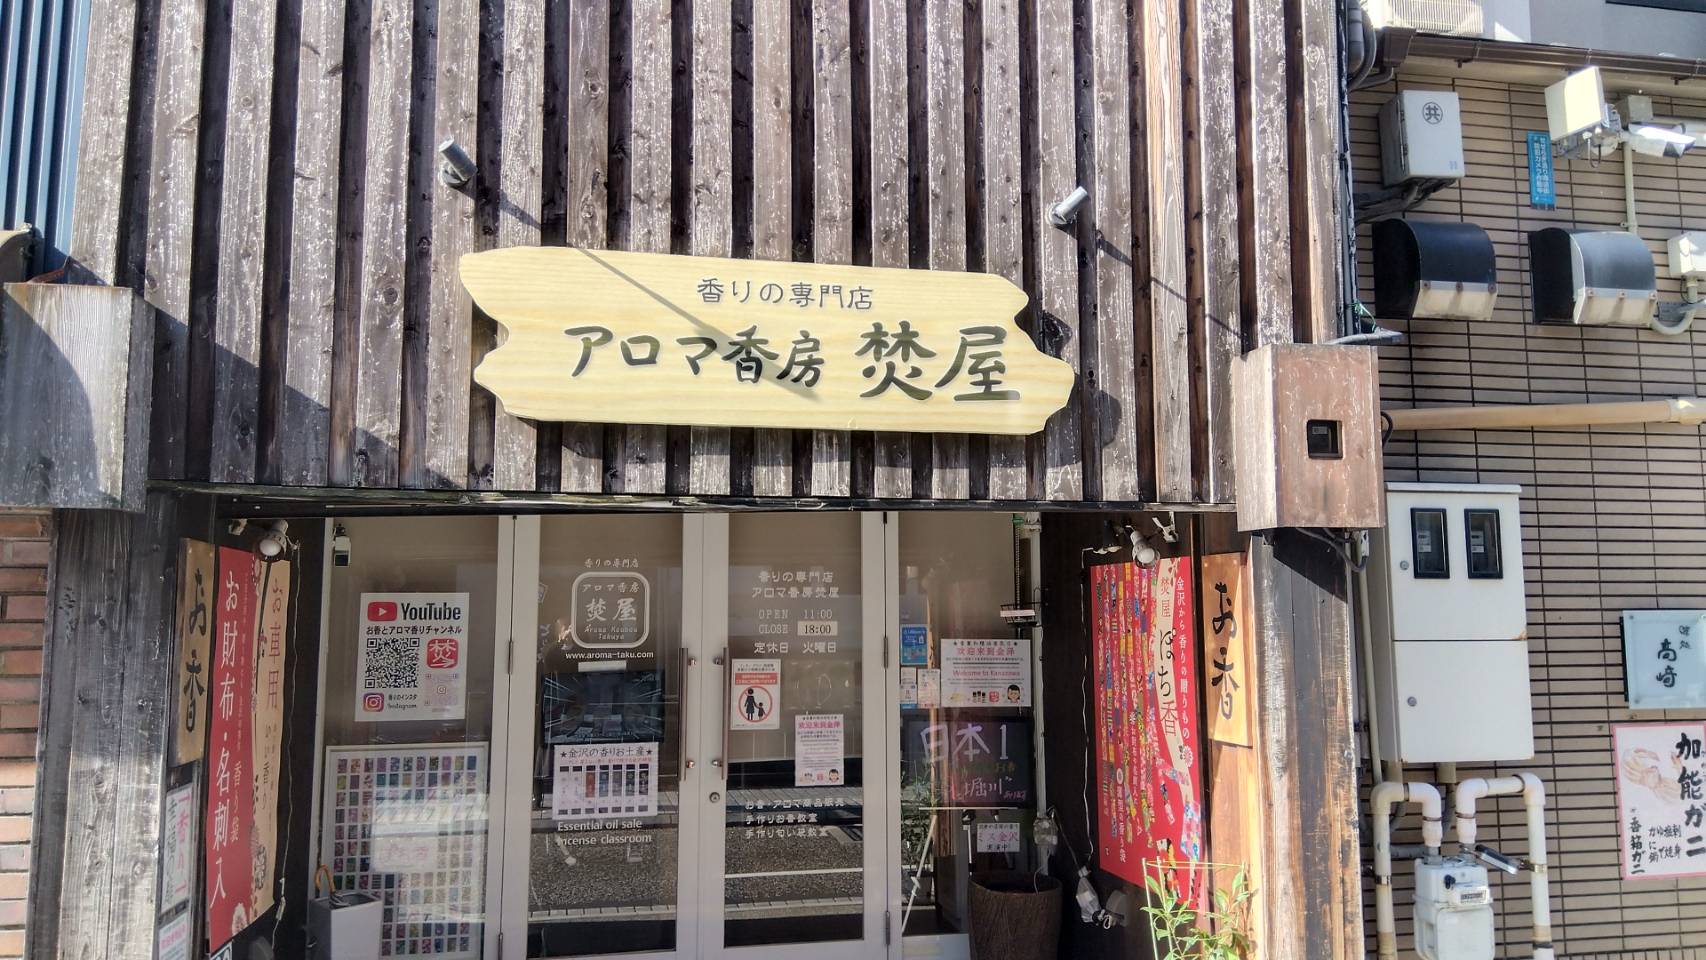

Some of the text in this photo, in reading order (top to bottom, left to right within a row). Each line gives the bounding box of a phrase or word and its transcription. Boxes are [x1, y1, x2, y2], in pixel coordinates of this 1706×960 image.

[697, 277, 874, 311] 香りの専門店
[564, 320, 1021, 402] アロマ香房 焚屋
[584, 558, 639, 568] 香りの専門店
[758, 570, 833, 582] 香りの専門店
[582, 581, 640, 593] アロマ香房
[752, 586, 839, 598] アロマ香房焚屋
[1160, 578, 1171, 618] 焚屋
[401, 602, 461, 620] YouTube
[585, 597, 637, 621] 焚屋
[759, 609, 833, 619] OPEN 11:00
[759, 624, 831, 634] CLOSE 18:00
[754, 642, 837, 654] 定休日 火曜日
[1211, 581, 1241, 720] お香
[565, 651, 654, 660] www.aroma-taku.com
[1675, 732, 1706, 858] 加能ガニ
[557, 818, 642, 832] Essential oil sale
[558, 833, 651, 846] ncense classroom
